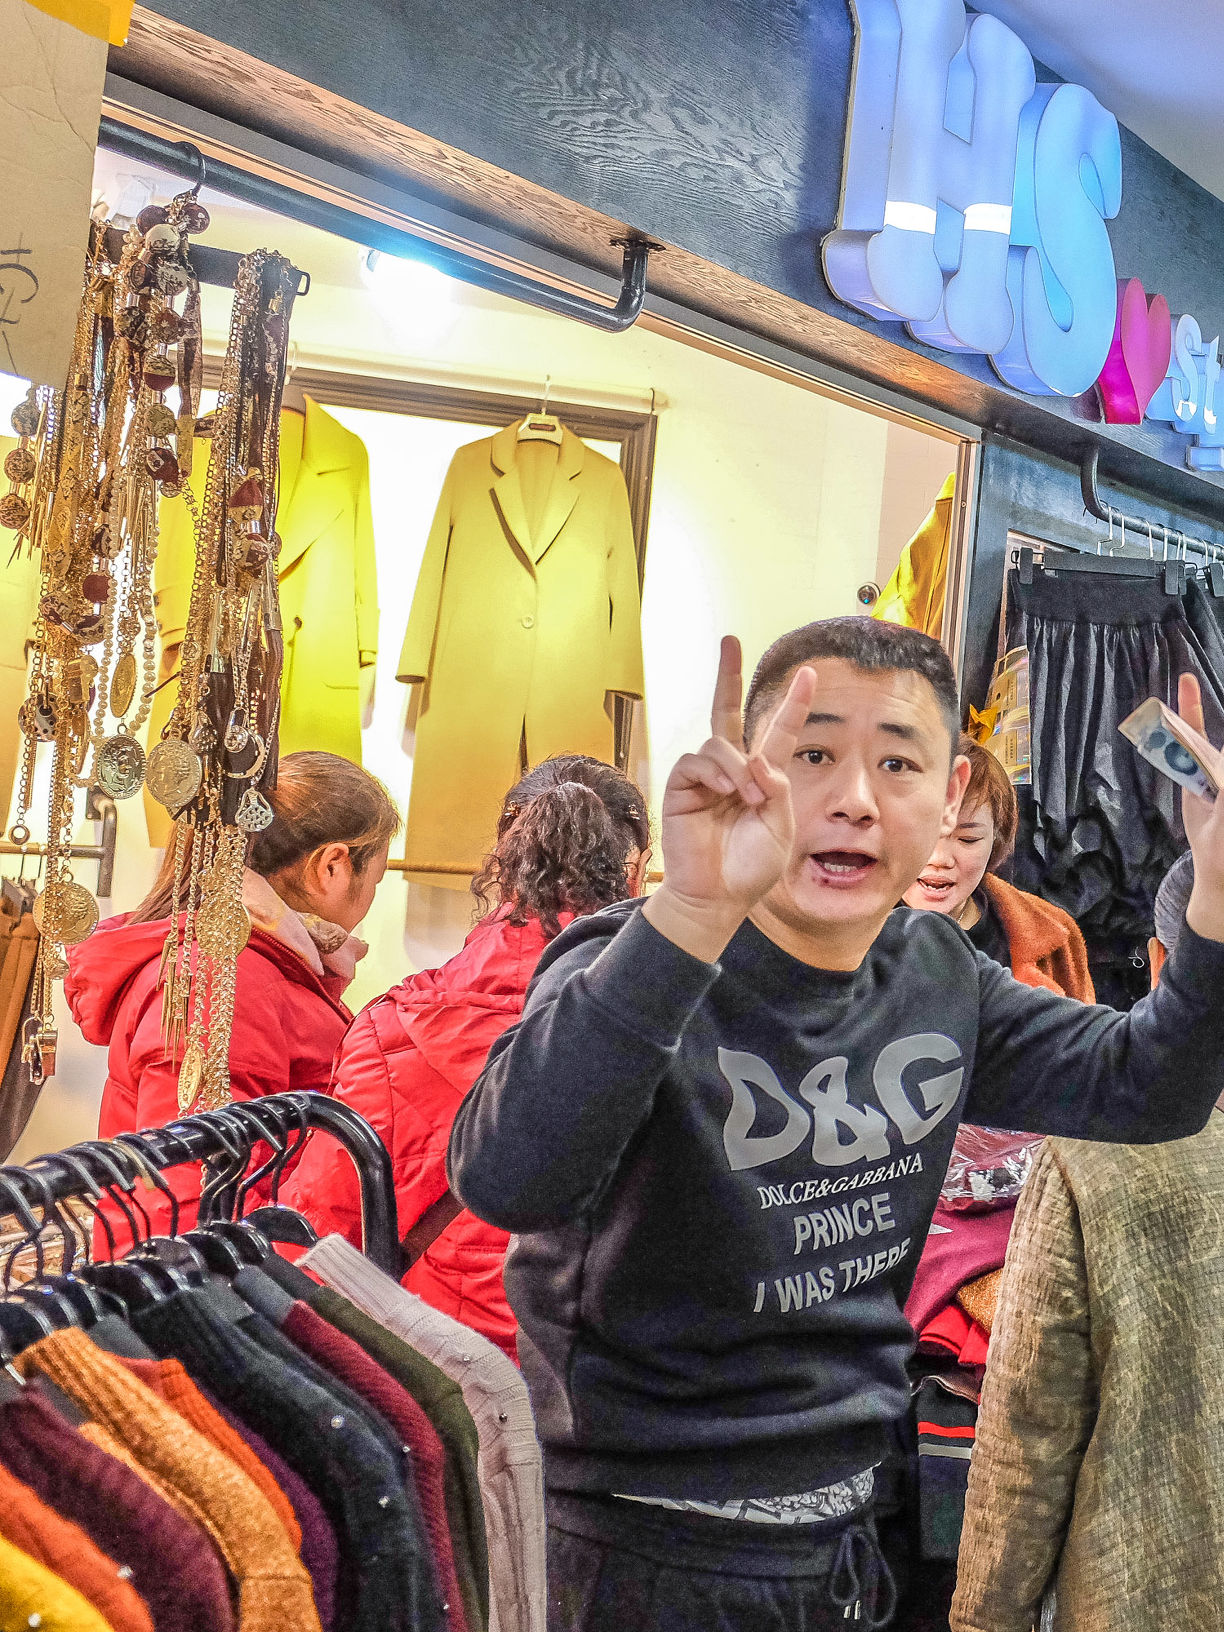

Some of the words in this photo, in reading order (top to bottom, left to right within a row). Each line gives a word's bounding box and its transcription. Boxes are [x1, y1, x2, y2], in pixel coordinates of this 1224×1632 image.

[718, 1032, 965, 1171] D&G
[757, 1152, 924, 1210] DOLCE&GABBANA
[793, 1192, 896, 1255] PRINCE
[753, 1281, 766, 1313] I
[774, 1265, 836, 1313] WAS
[838, 1237, 912, 1293] THERE
